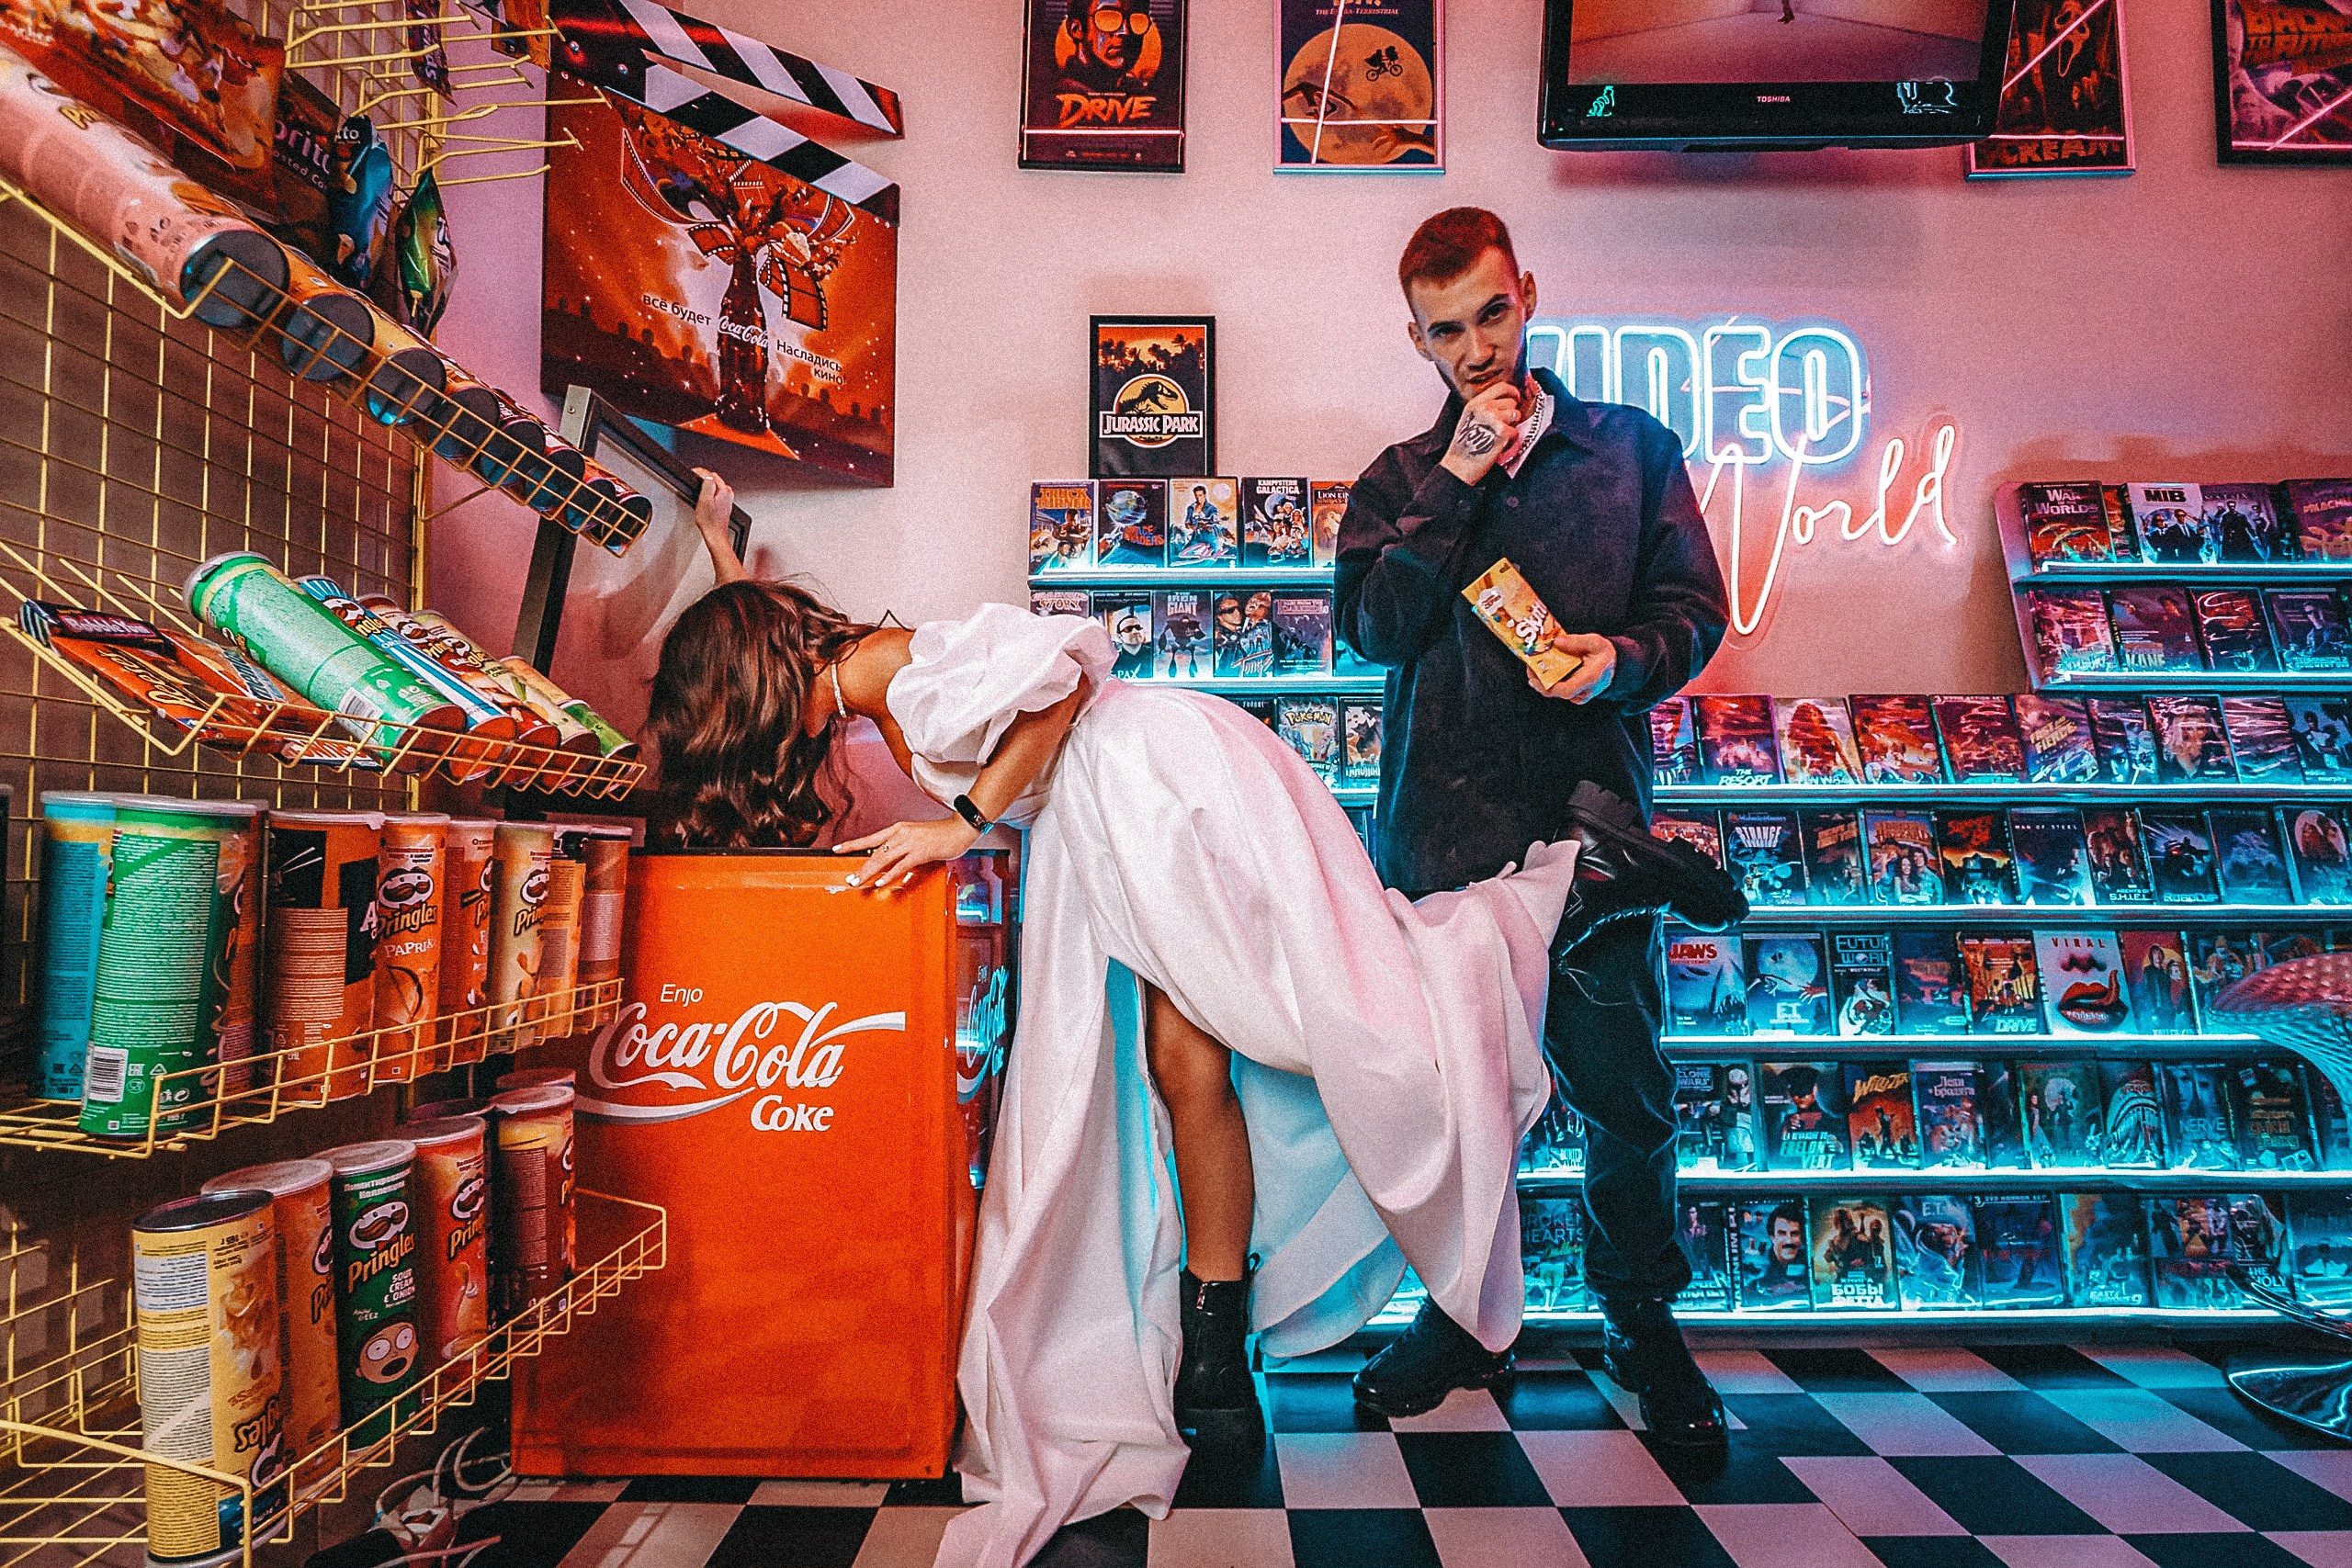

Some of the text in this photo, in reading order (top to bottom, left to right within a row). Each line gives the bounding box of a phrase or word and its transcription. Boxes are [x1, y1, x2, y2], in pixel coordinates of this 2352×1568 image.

[1056, 93, 1157, 130] DRIVE
[643, 293, 711, 326] всё будет
[718, 315, 769, 348] Coca-Cola
[777, 340, 843, 372] Насладись
[814, 367, 845, 386] кино!
[1104, 415, 1199, 434] JURASSIC PARK
[1040, 488, 1090, 499] TRUCK
[1255, 486, 1301, 495] GALACTICA
[1317, 491, 1337, 499] LION
[2143, 490, 2187, 502] MIB
[2035, 502, 2099, 514] WORLDS
[1700, 425, 1957, 635] World
[1035, 599, 1082, 612] STORY
[1167, 603, 1198, 615] GIANT
[1718, 774, 1773, 785] RESORT
[384, 938, 436, 958] PAPRIK
[1836, 935, 1889, 952] FUTU
[2052, 937, 2105, 948] VIRAL
[1668, 943, 1717, 960] JAWS
[1841, 953, 1889, 964] WORL
[661, 984, 703, 1007] Enjo
[1995, 1017, 2037, 1032] DRIVE
[589, 1001, 845, 1089] Coca-Cola
[751, 1095, 834, 1131] Coke
[2179, 1116, 2227, 1134] NERVE
[1831, 1283, 1883, 1296] БОБЫ
